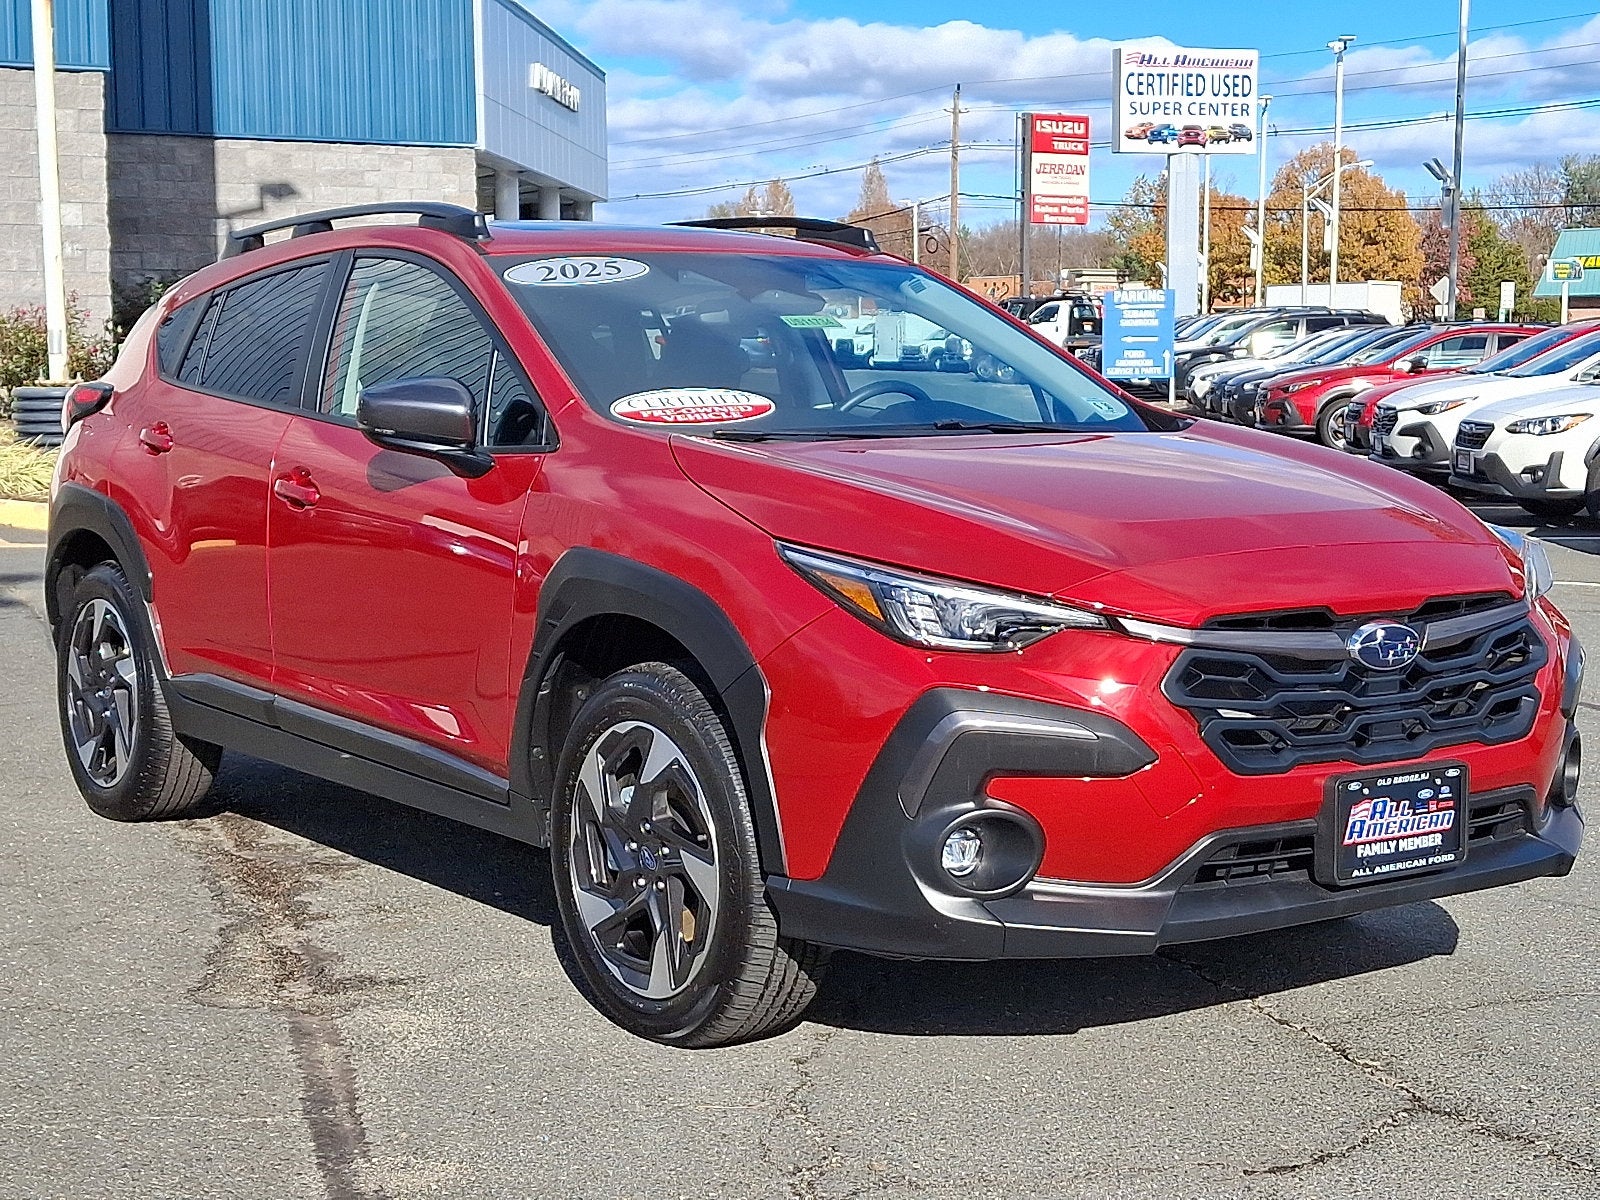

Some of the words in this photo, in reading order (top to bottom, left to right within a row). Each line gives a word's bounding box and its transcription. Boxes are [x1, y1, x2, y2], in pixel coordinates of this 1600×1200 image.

[1125, 71, 1206, 97] CERTIFIED
[1211, 73, 1252, 98] USED
[1129, 101, 1183, 116] SUPER
[1187, 101, 1250, 117] CENTER
[1035, 119, 1086, 135] ISUZU
[1052, 141, 1084, 152] TRUCK
[535, 260, 623, 282] 2025
[1113, 290, 1166, 303] PARKING
[639, 404, 753, 418] PRE-OWNED
[661, 411, 744, 422] VEHICLE
[1357, 840, 1398, 858] FAMILY
[1398, 833, 1442, 852] MEMBER
[1352, 867, 1372, 877] ALL
[1374, 858, 1427, 874] AMERICAN
[1428, 853, 1455, 865] FORD
